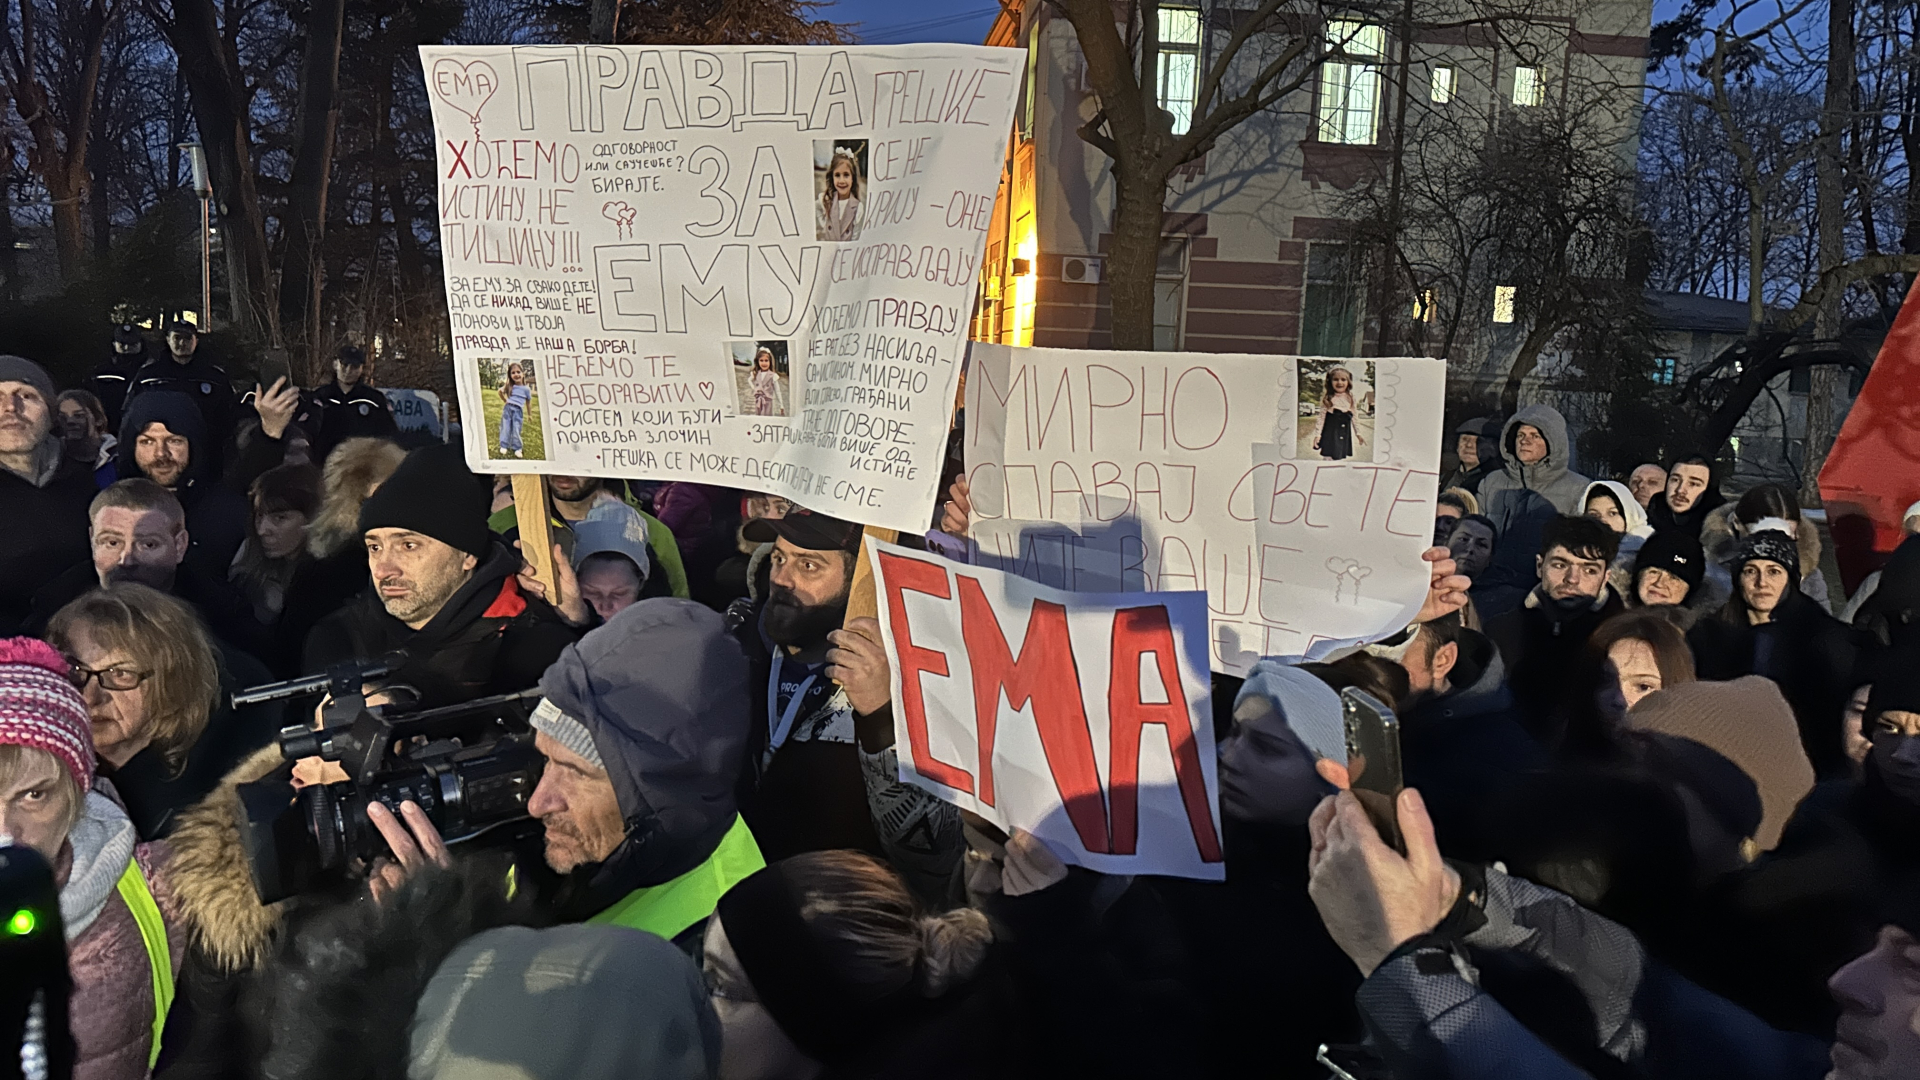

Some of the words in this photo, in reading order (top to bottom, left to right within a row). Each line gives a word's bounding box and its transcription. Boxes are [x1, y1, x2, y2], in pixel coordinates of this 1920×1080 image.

[437, 71, 491, 96] ЕМА
[512, 46, 862, 132] ПРАВДА
[872, 69, 1010, 130] ГРЕШКЕ
[446, 140, 580, 183] ХОЋЕМО
[592, 140, 678, 157] ОДГОВОРНОСТ
[874, 140, 902, 181] СЕ
[903, 137, 931, 178] НЕ
[585, 160, 609, 171] ИЛИ
[592, 176, 665, 193] БИРАЈТЕ.
[685, 145, 799, 237] ЗА
[443, 185, 531, 224] ИСТИНУ,
[539, 188, 574, 224] НЕ
[863, 187, 919, 231] КРИЈУ
[831, 249, 852, 284] СЕ
[851, 243, 974, 287] ИСПРАВЉАЈУ
[450, 276, 470, 292] ЗА
[505, 278, 522, 293] ЗА
[527, 280, 560, 294] СВАКО
[563, 280, 596, 296] ДЕТЕ!
[594, 244, 821, 337] ЕМУ
[450, 293, 470, 312] ДА
[474, 294, 489, 308] СЕ
[492, 294, 532, 311] НИКАД
[536, 297, 571, 312] ВИШЕ
[577, 297, 596, 314] НЕ
[811, 301, 861, 334] ХОЋЕМО
[863, 298, 958, 336] ПРАВДУ,
[524, 314, 565, 331] ТВОЈА
[455, 335, 510, 352] ПРАВДА
[515, 336, 530, 350] ЈЕ
[535, 336, 575, 352] НАША
[584, 339, 637, 354] БОРБА!
[808, 339, 823, 358] НЕ
[864, 333, 937, 366] НАСИЉА
[546, 355, 634, 379] НЕЋЕМО
[644, 355, 681, 377] ТЕ
[859, 362, 927, 393] МИРНО
[550, 382, 695, 407] ЗАБОРАВИТИ
[844, 385, 910, 412] ГРАЂАНИ
[974, 359, 1229, 453] МИРНО
[558, 408, 622, 427] СИСТЕМ
[632, 410, 674, 426] КОЈИ
[557, 429, 637, 445] ПОНАВЉА
[646, 429, 711, 445] ЗЛОЧИН
[840, 436, 881, 456] ВИШЕ
[885, 446, 911, 465] ОД
[602, 448, 657, 469] ГРЕШКА
[665, 452, 682, 470] СЕ
[690, 452, 740, 474] МОЖЕ
[815, 475, 831, 495] НЕ
[834, 480, 882, 508] СМЕ.
[850, 455, 918, 481] ИСТИНЕ
[968, 460, 1197, 523] СПАВАЈ
[1227, 462, 1439, 538] СВЕТЕ
[1120, 535, 1303, 625] ВАШЕ
[877, 549, 1224, 863] ЕМА
